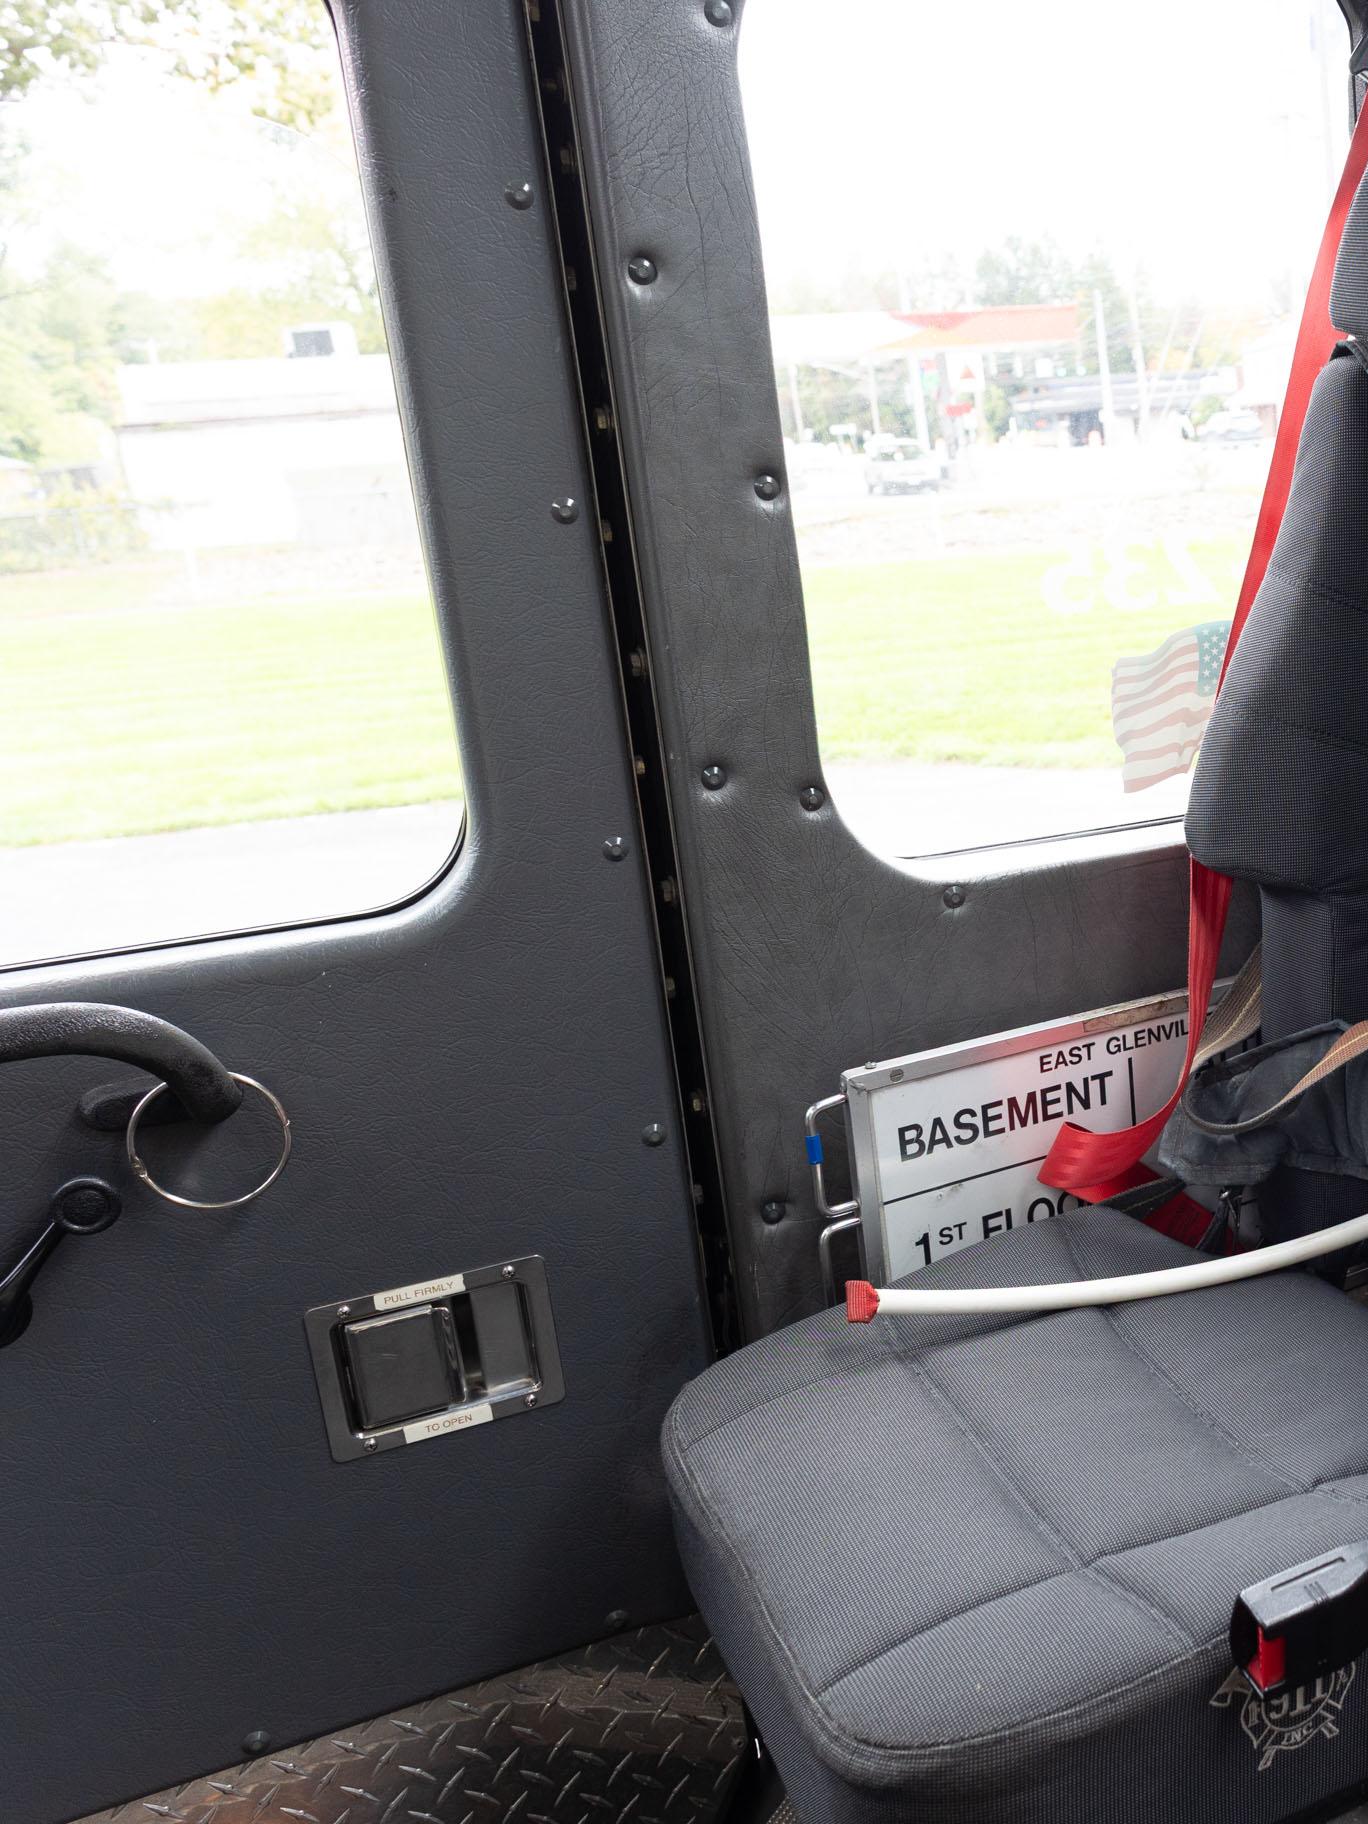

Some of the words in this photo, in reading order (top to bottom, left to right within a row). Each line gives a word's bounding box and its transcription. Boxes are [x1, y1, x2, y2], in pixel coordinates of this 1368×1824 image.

[1039, 1042, 1095, 1074] EAST
[898, 1070, 1115, 1162] BASEMENT
[384, 1291, 411, 1305] PULL
[414, 1280, 454, 1298] FIRMLY
[425, 1423, 440, 1433] TO
[442, 1413, 473, 1429] OPEN
